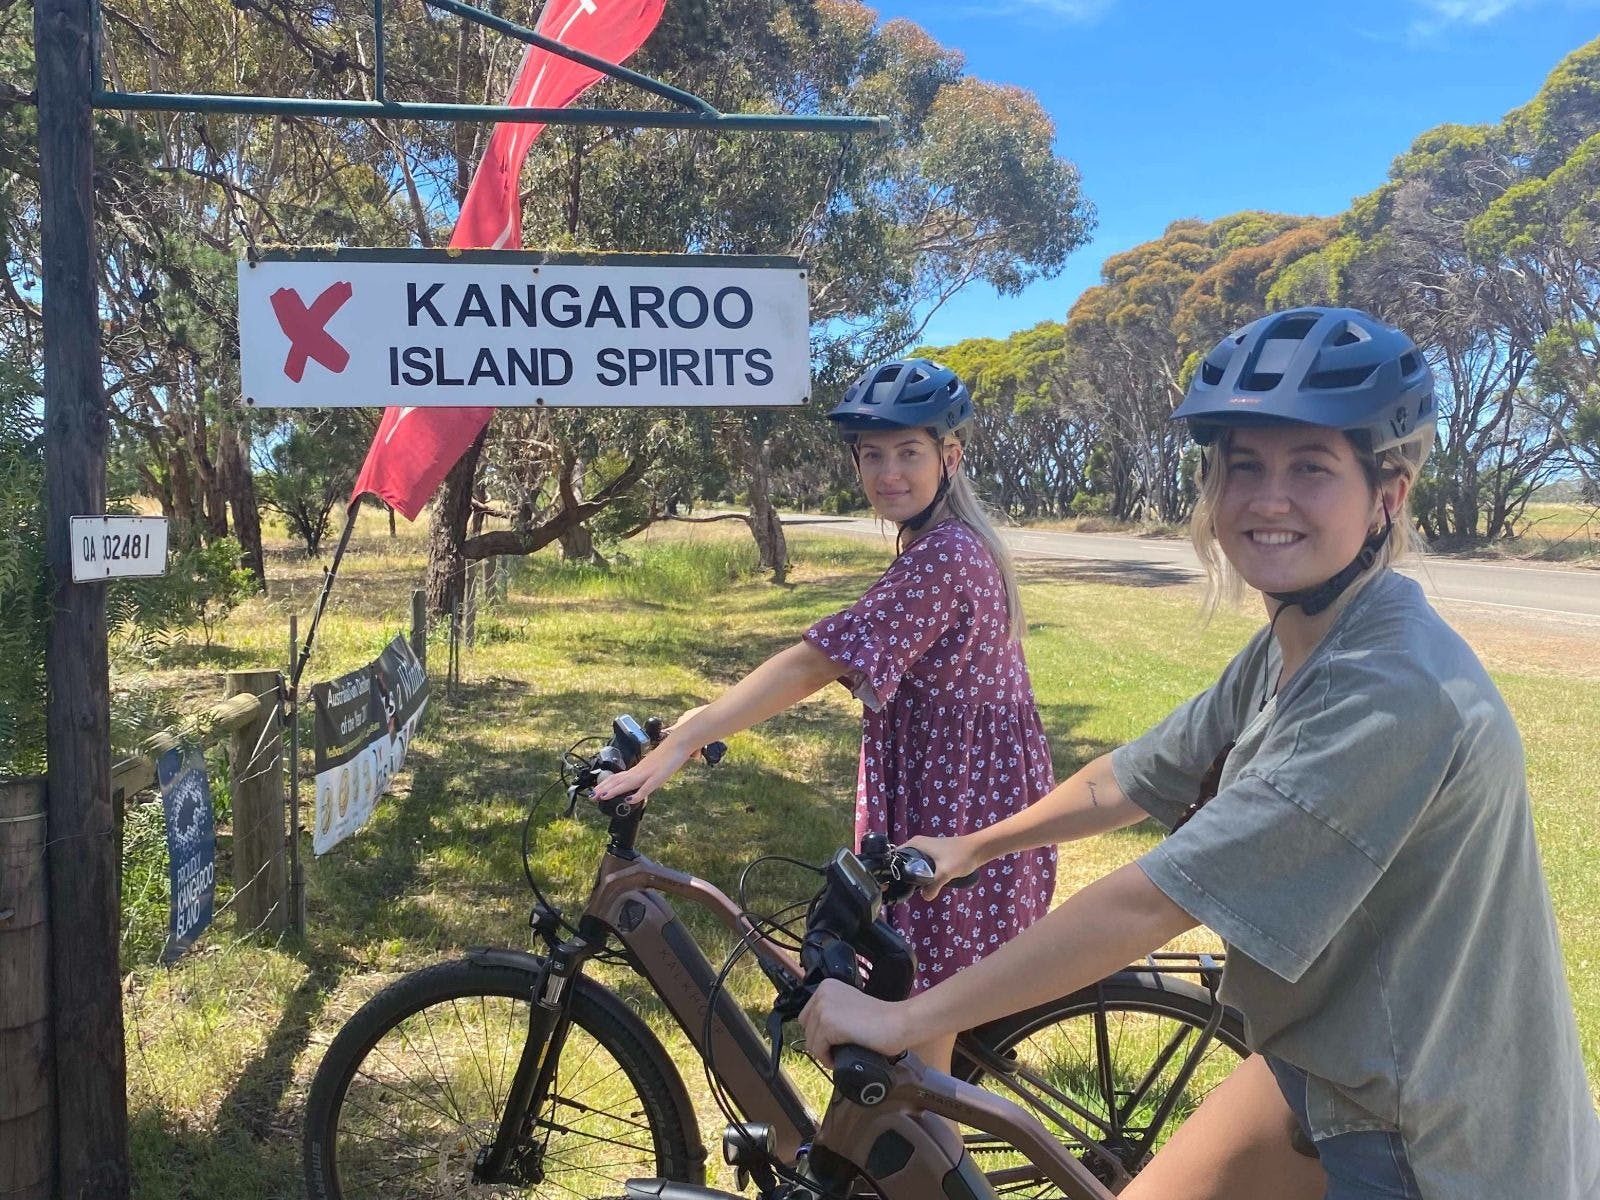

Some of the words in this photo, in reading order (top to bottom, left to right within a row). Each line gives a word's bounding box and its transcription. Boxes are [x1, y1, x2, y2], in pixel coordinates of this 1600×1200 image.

[406, 282, 754, 330] KANGAROO
[389, 346, 574, 387] ISLAND
[596, 347, 775, 387] SPIRITS
[82, 535, 97, 562] QA
[177, 861, 214, 914] KANGAROO
[176, 899, 200, 941] ISLAND
